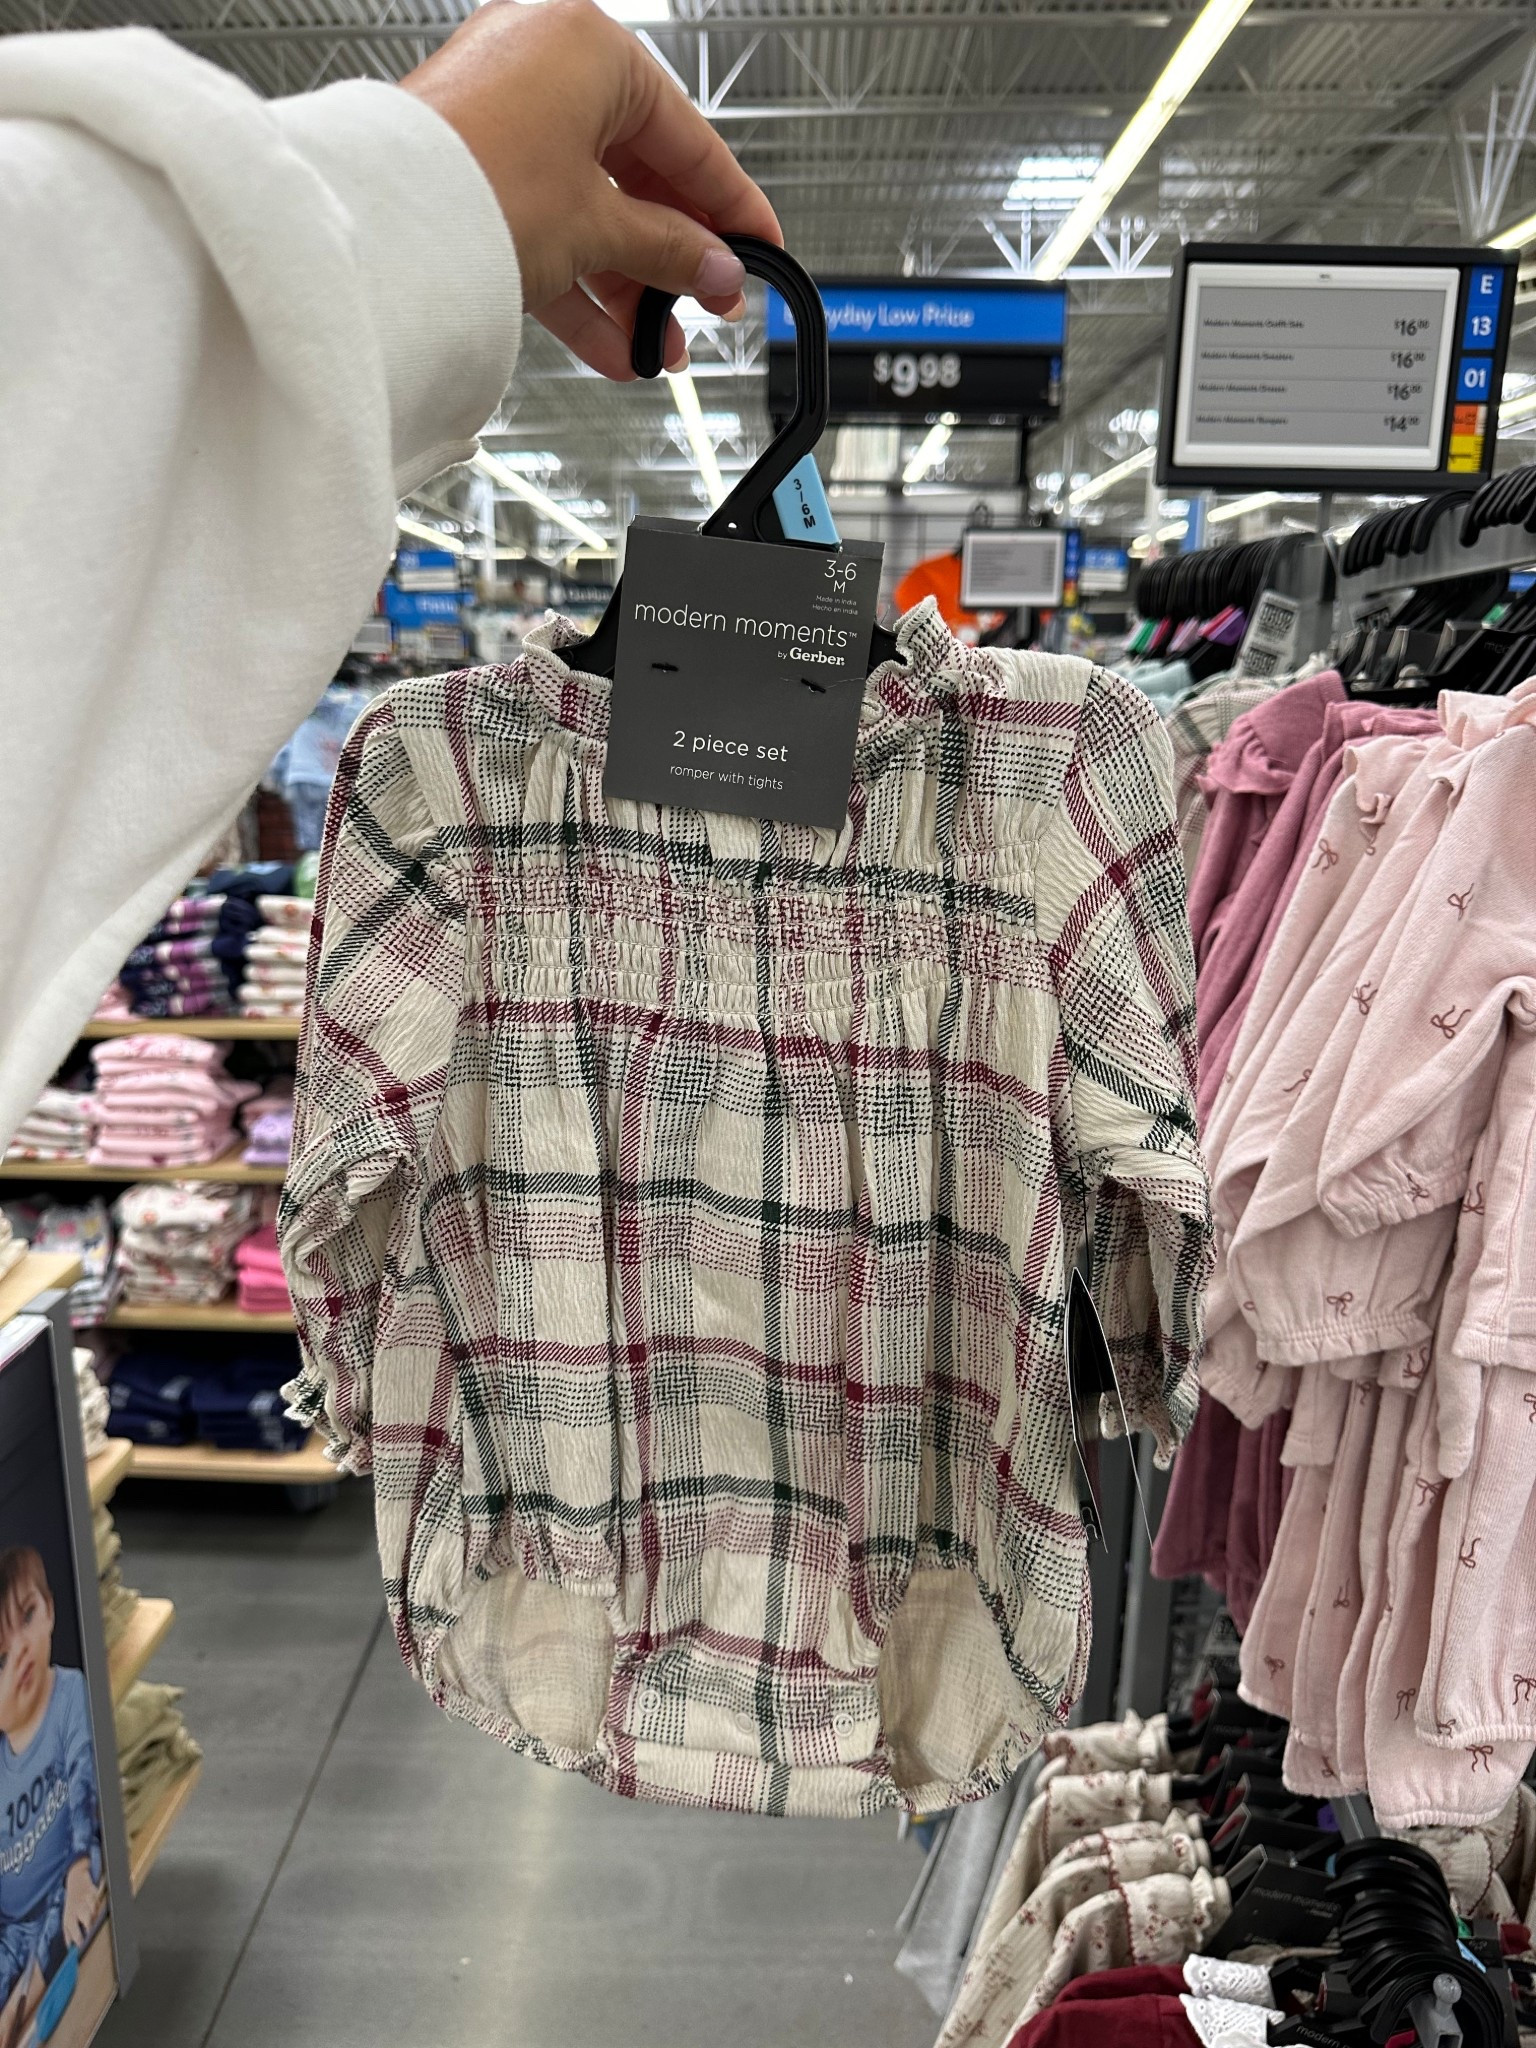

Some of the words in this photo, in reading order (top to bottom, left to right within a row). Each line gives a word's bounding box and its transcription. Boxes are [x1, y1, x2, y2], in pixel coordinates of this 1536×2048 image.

[1480, 274, 1494, 294] E
[878, 301, 920, 327] Low
[922, 302, 975, 328] Price
[1471, 316, 1492, 336] 13
[1464, 368, 1487, 388] 01
[824, 559, 857, 581] 3-6
[833, 580, 846, 594] M
[812, 603, 833, 612] Hecho
[816, 594, 833, 603] Made
[841, 598, 857, 606] India
[634, 603, 726, 631] modern
[777, 650, 788, 660] by
[673, 730, 686, 748] 2
[692, 734, 749, 757] piece
[756, 745, 789, 762] set
[670, 765, 715, 780] romper
[718, 771, 745, 785] with
[748, 774, 784, 790] tights
